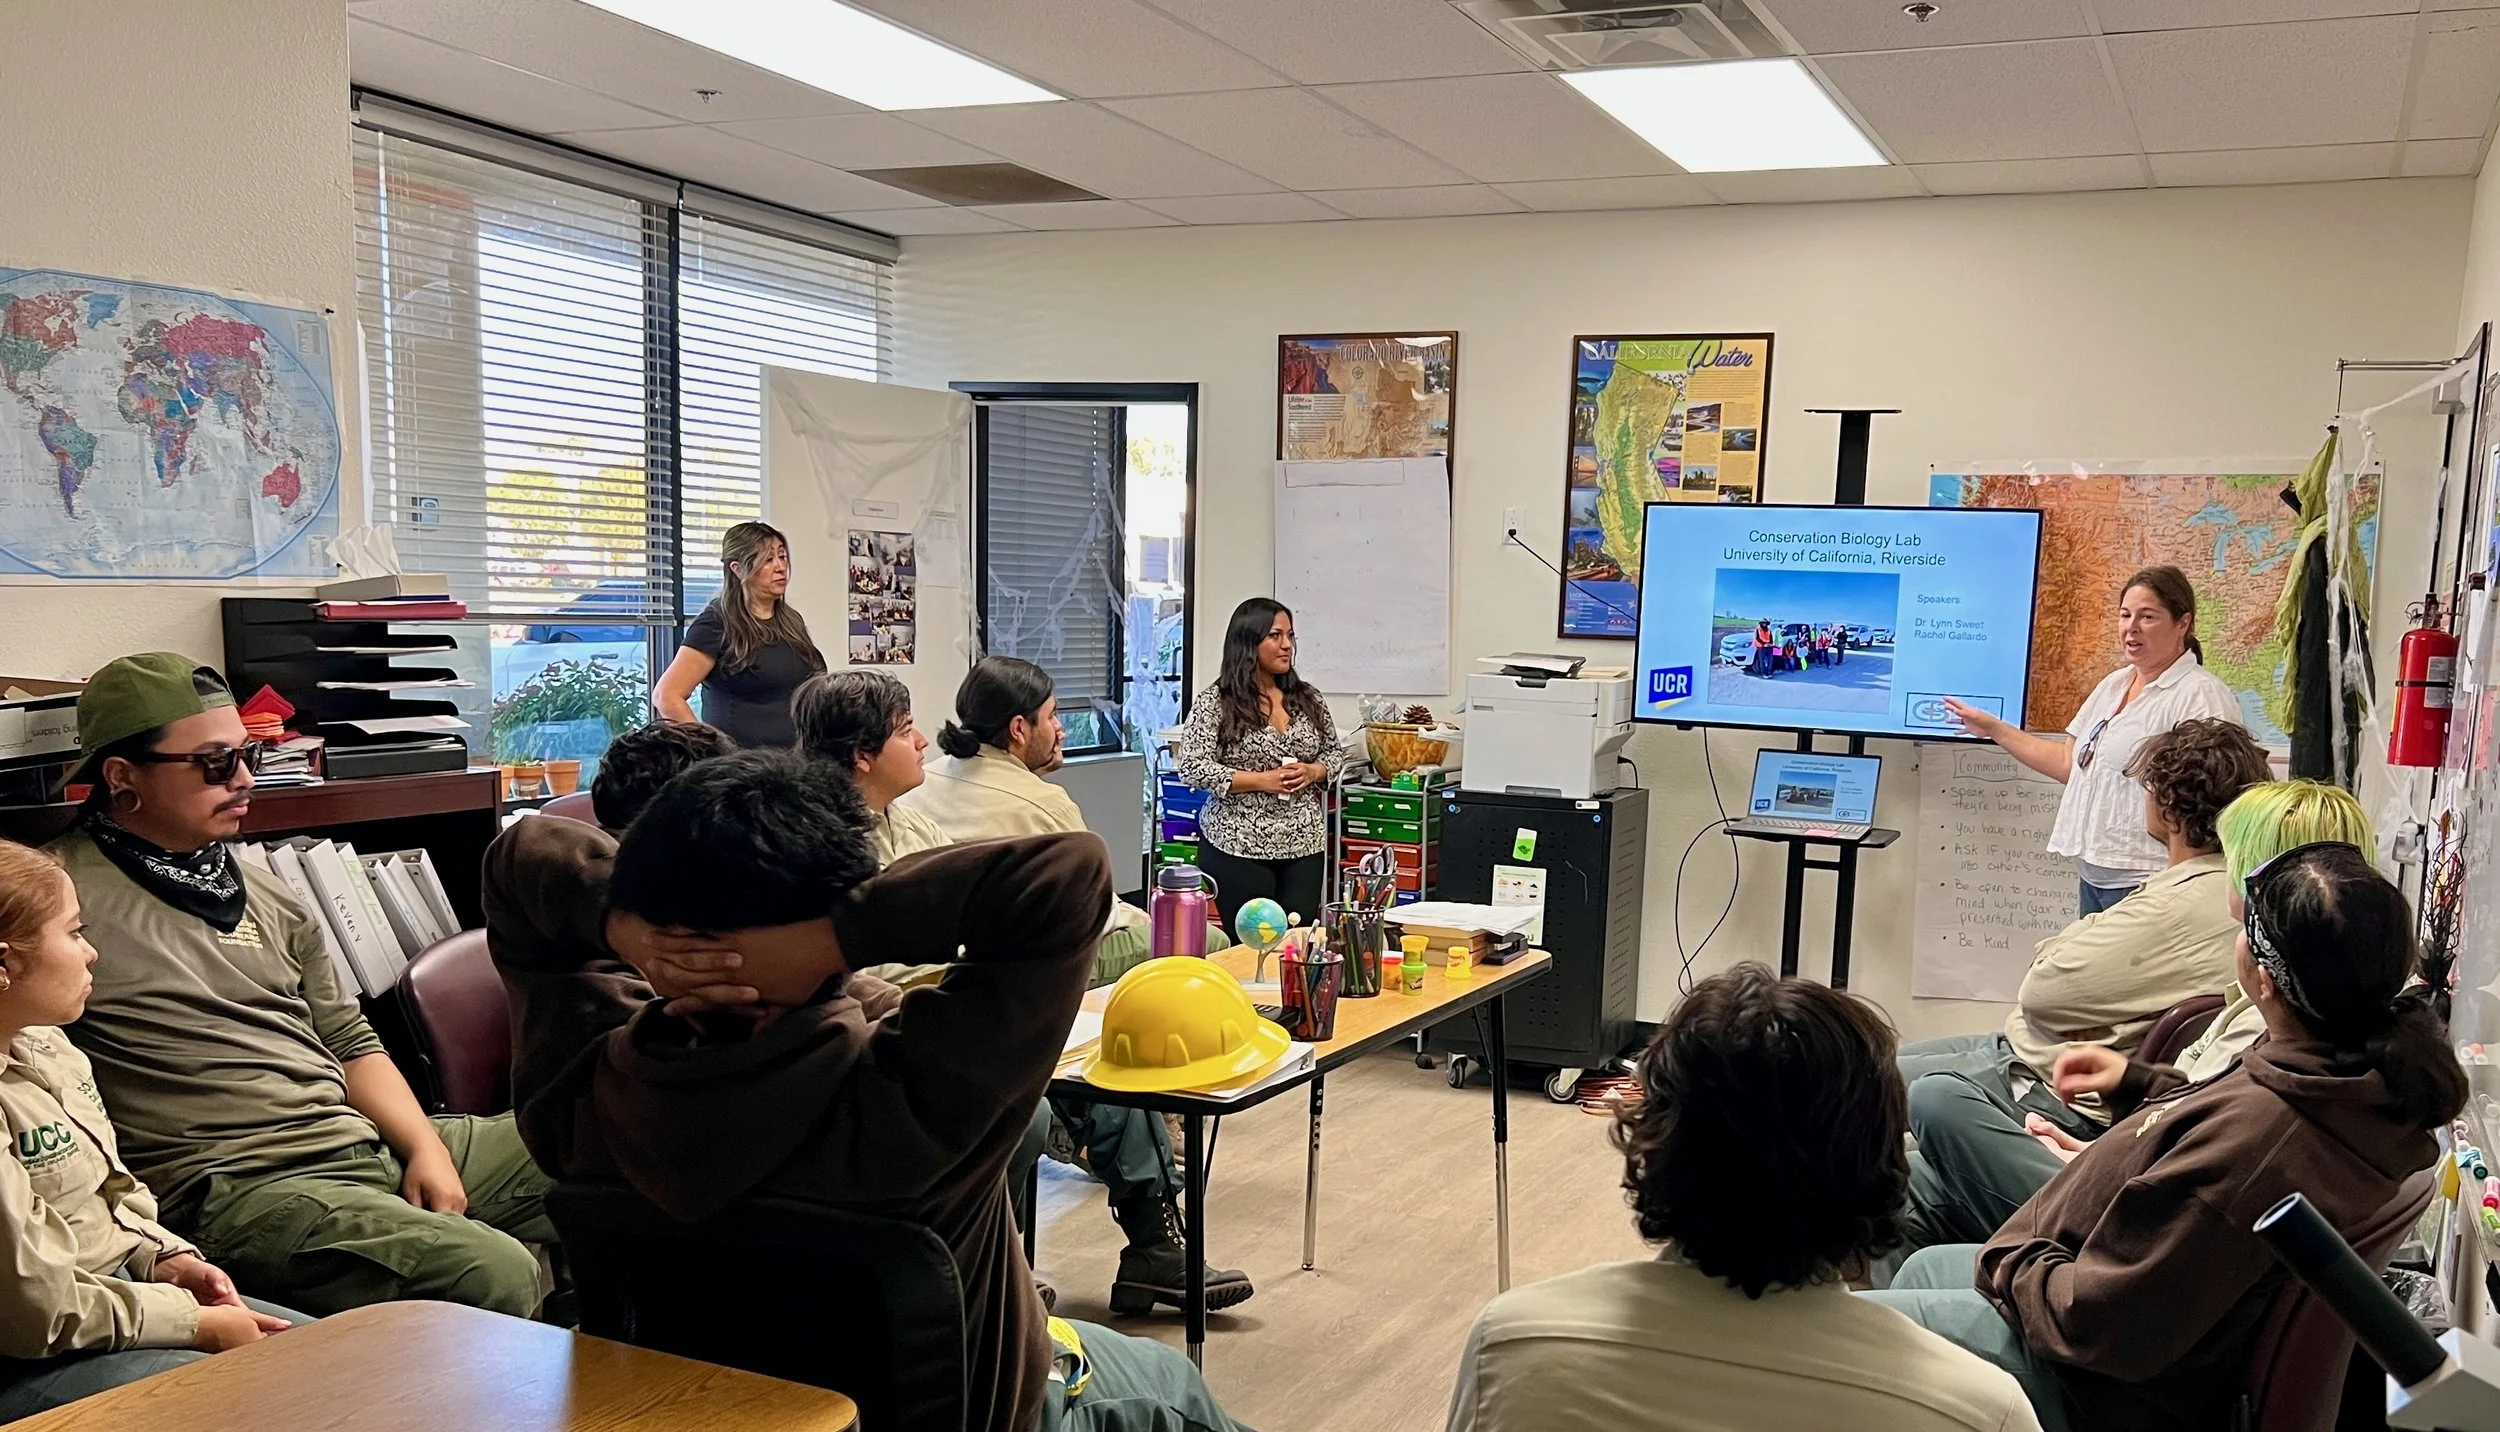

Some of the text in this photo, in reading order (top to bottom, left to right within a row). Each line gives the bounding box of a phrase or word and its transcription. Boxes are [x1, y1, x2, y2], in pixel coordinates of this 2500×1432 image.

[1340, 344, 1387, 361] COLORADO
[1420, 343, 1445, 360] BASIN
[1584, 340, 1753, 369] CALIFORNIA Water
[1748, 530, 1922, 549] Conservation Biology Lab
[1723, 547, 1946, 566] University of California, Riverside
[1930, 618, 1953, 629] Lynn
[1955, 619, 1985, 629] Sweet
[1914, 630, 1988, 641] Rachel Gallardo
[1653, 671, 1688, 694] UCR
[1959, 753, 2018, 777] Community
[1995, 790, 2009, 799] up
[2016, 786, 2032, 798] for
[1998, 800, 2022, 817] being
[2031, 803, 2059, 815] mist
[1982, 822, 2005, 836] have
[2011, 828, 2017, 836] a
[2022, 828, 2051, 843] right
[1955, 843, 1979, 855] Ask
[2004, 849, 2022, 860] you
[2027, 851, 2047, 861] can
[1955, 878, 1969, 890] Be
[1979, 884, 2004, 895] open
[2010, 883, 2021, 894] to
[1995, 898, 2022, 910] when
[1960, 911, 2061, 931] presented with new
[1959, 931, 1975, 948] Be
[18, 1121, 72, 1158] UCC
